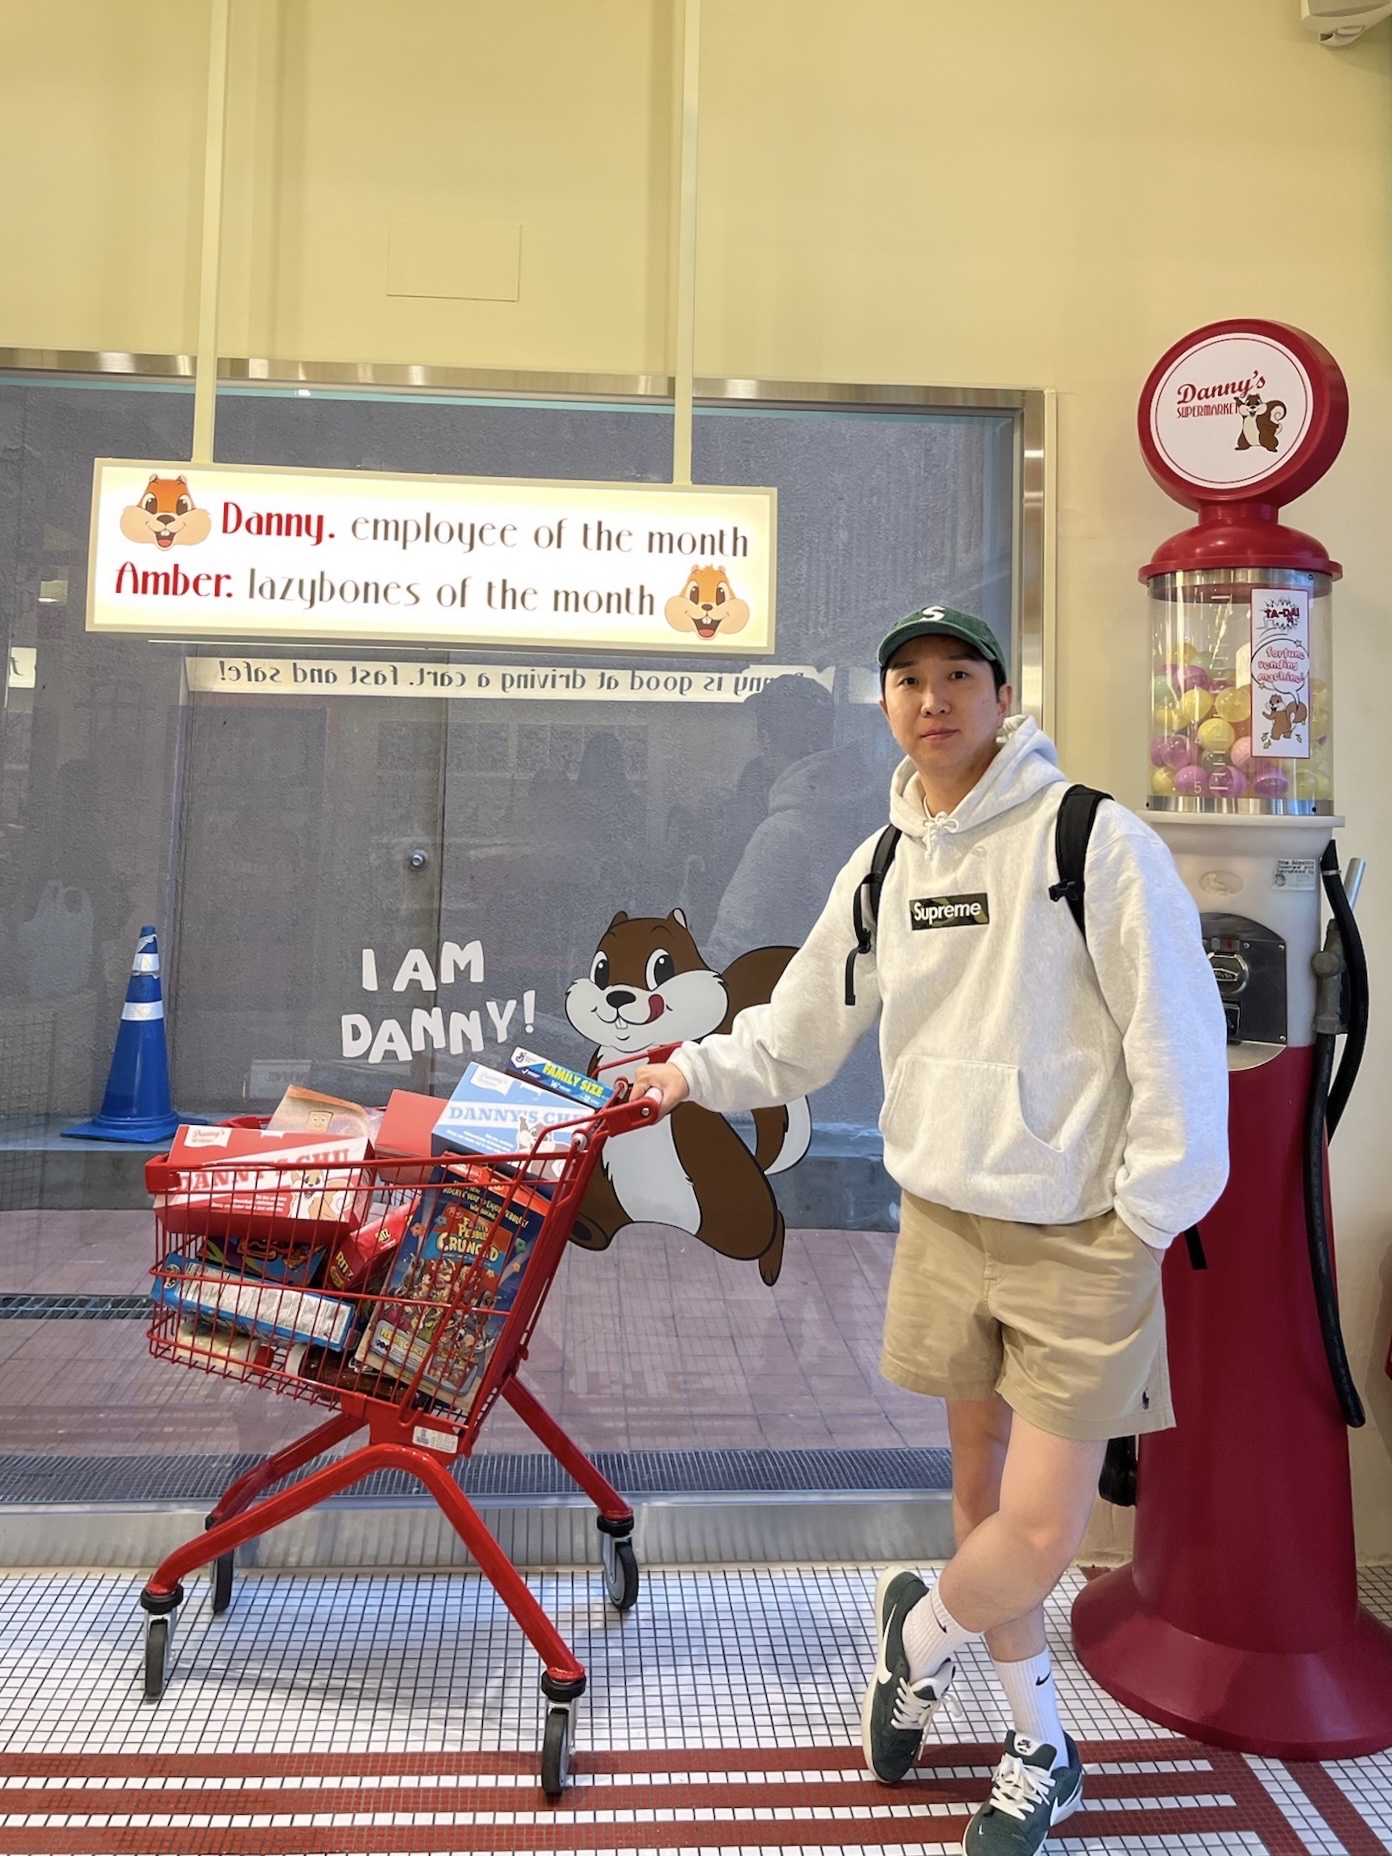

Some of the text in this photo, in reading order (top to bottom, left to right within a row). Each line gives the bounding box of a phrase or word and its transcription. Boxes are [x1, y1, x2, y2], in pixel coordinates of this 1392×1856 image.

[1176, 370, 1266, 405] Danny's
[222, 501, 748, 557] Danny. employee of the month
[115, 561, 655, 616] Amber. lazybones of the month
[920, 605, 946, 621] S
[1257, 660, 1298, 671] vending
[1266, 646, 1305, 660] fortune
[914, 902, 982, 925] Supreme
[362, 940, 485, 992] I AM
[341, 990, 536, 1064] DANNY!
[542, 1061, 582, 1088] FAMILY
[580, 1079, 605, 1098] SIZE
[448, 1106, 539, 1124] DANNY'S
